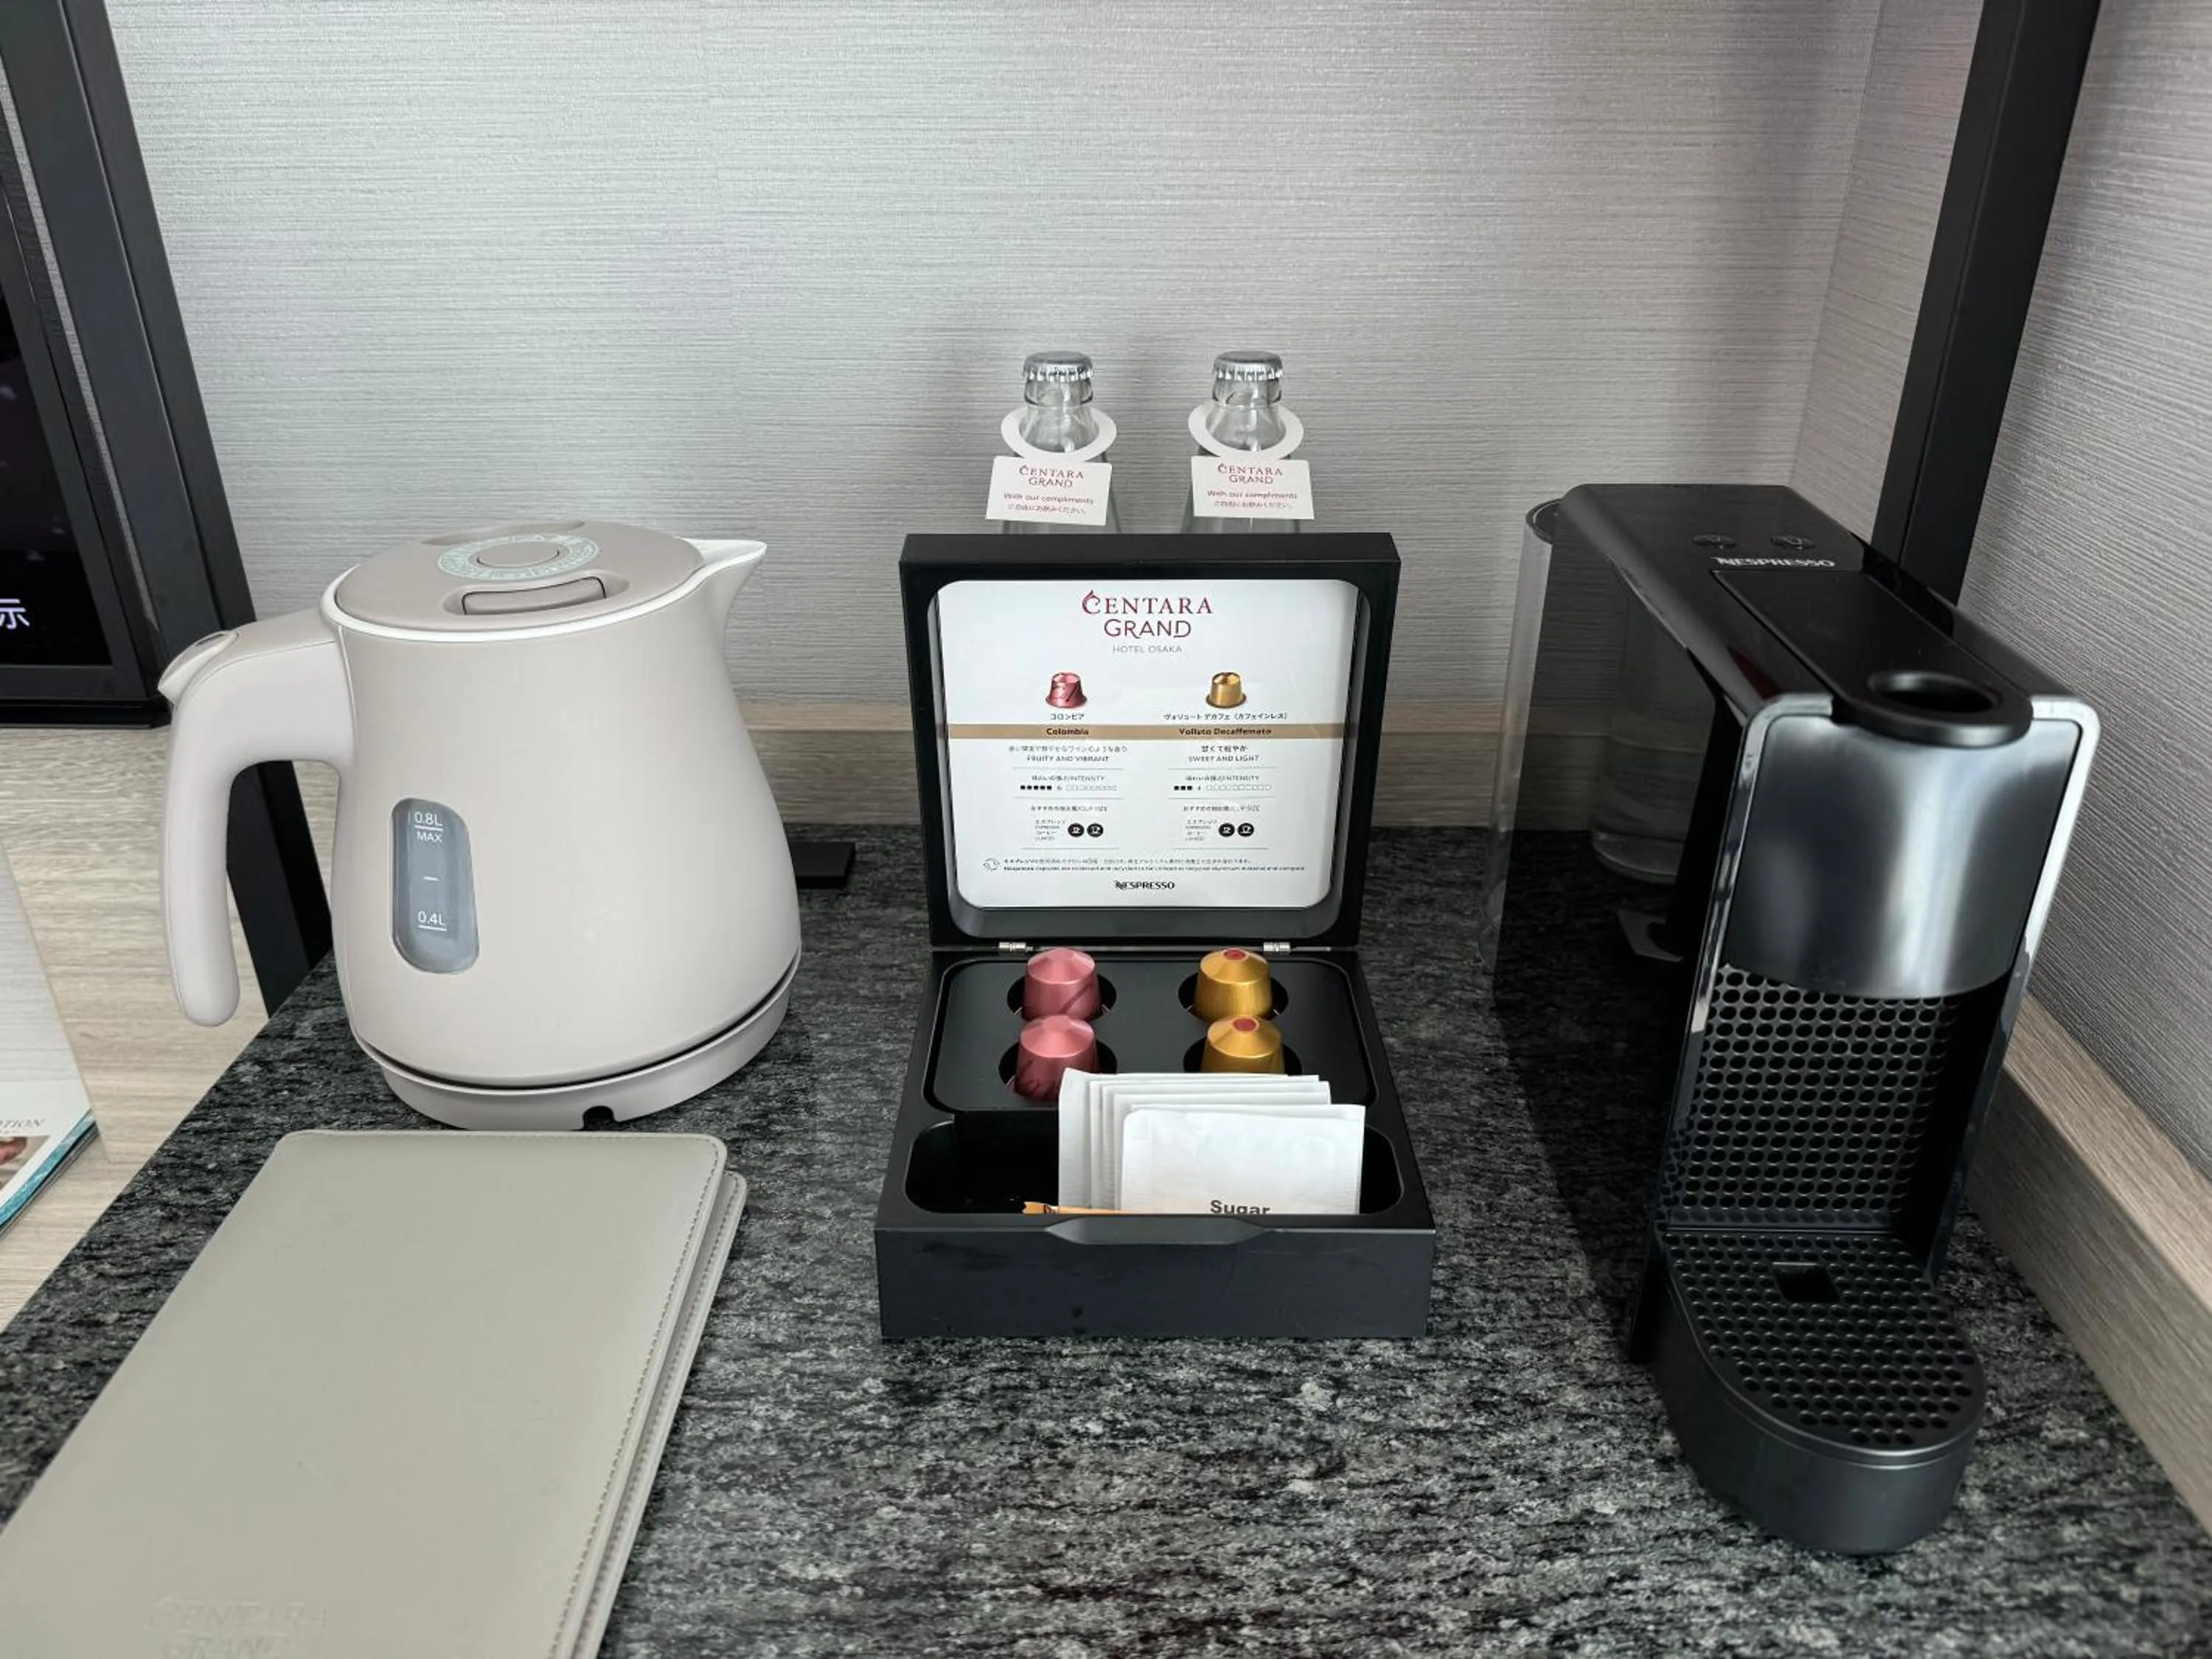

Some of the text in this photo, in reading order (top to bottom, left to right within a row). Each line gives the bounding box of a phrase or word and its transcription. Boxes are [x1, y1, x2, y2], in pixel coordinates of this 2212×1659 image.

[1019, 465, 1084, 479] CENTARA
[1217, 462, 1283, 476] CENTARA
[1029, 477, 1073, 487] GRAND
[1229, 474, 1273, 484] GRAND
[1711, 557, 1835, 567] NESPRESSO
[1082, 590, 1213, 614] CENTARA
[1104, 619, 1192, 639] GRAND
[1113, 645, 1182, 653] HOTEL OSAKA
[414, 811, 442, 827] 0.8L
[416, 830, 442, 843] MAX
[1114, 880, 1175, 890] NESPRESSO
[418, 911, 446, 925] 0.4L
[1210, 1199, 1270, 1214] Sugar
